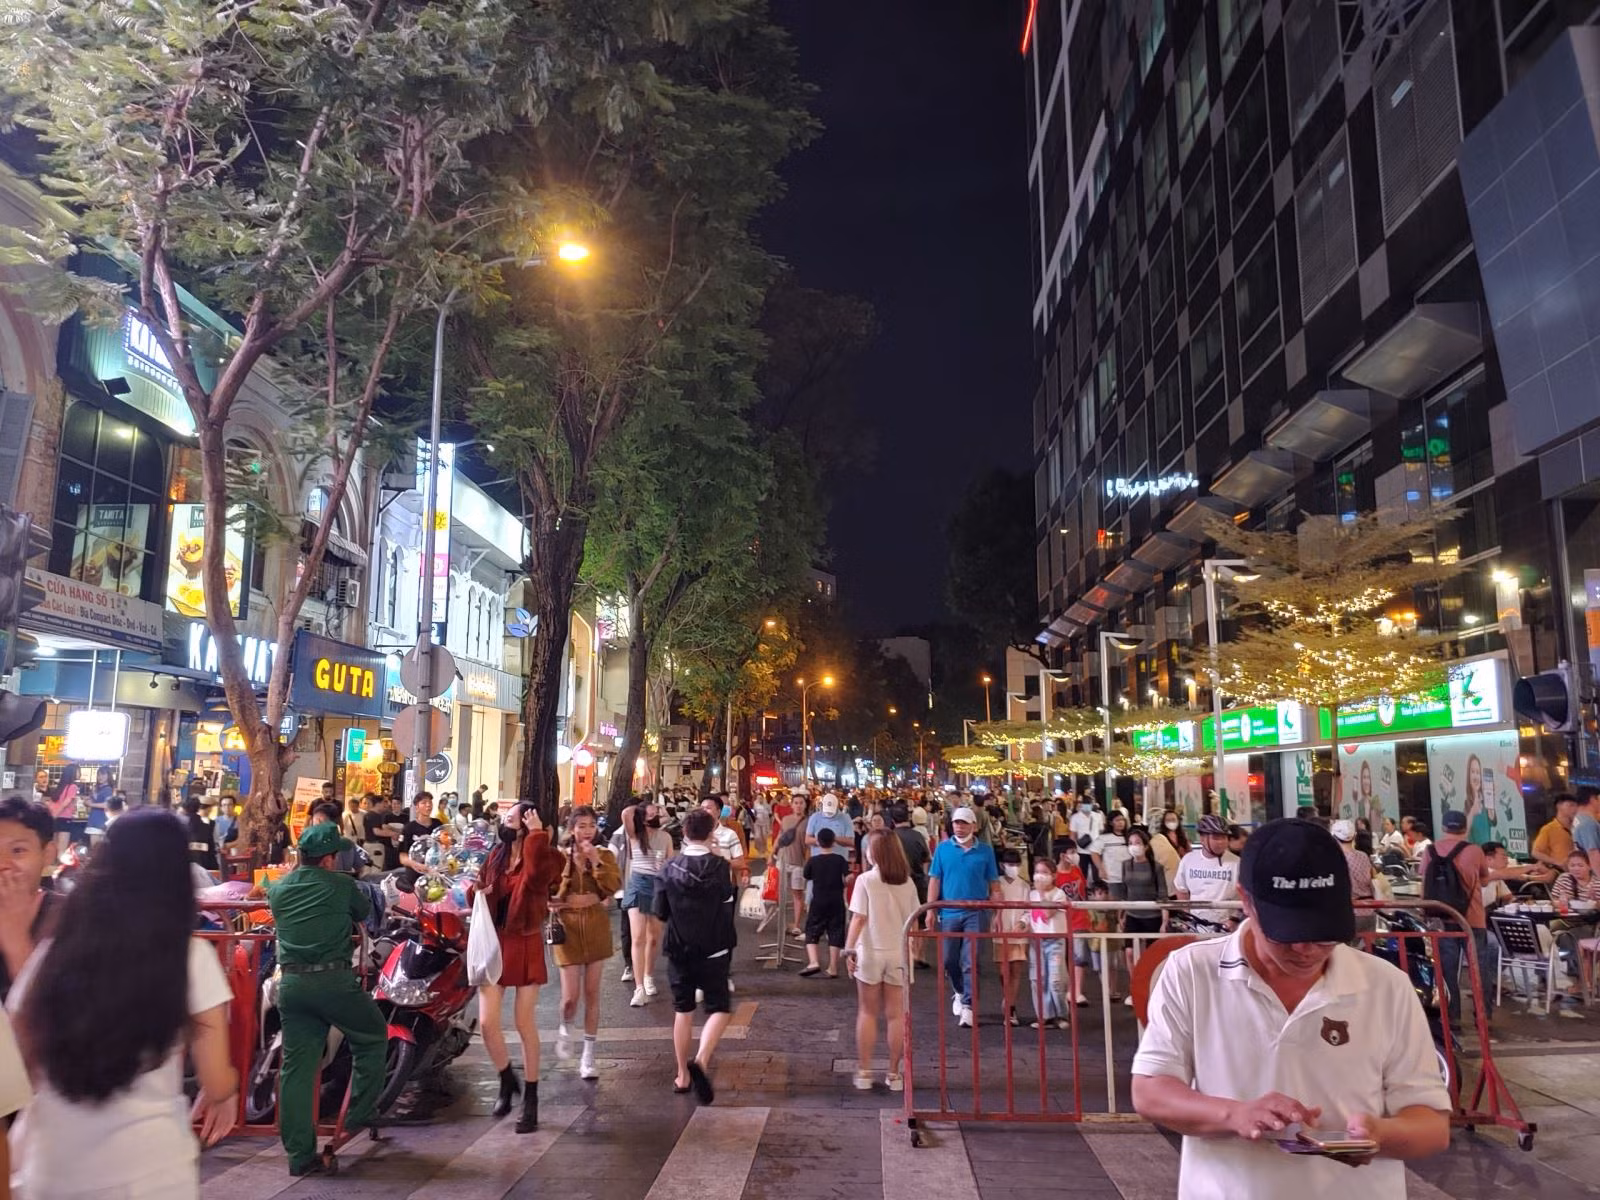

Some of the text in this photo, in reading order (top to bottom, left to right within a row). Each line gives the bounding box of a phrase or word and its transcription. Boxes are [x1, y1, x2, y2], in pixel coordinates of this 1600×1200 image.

[110, 598, 115, 609] 1
[90, 608, 111, 625] Compact
[316, 658, 374, 698] GUTA
[1272, 873, 1335, 889] The Weird
